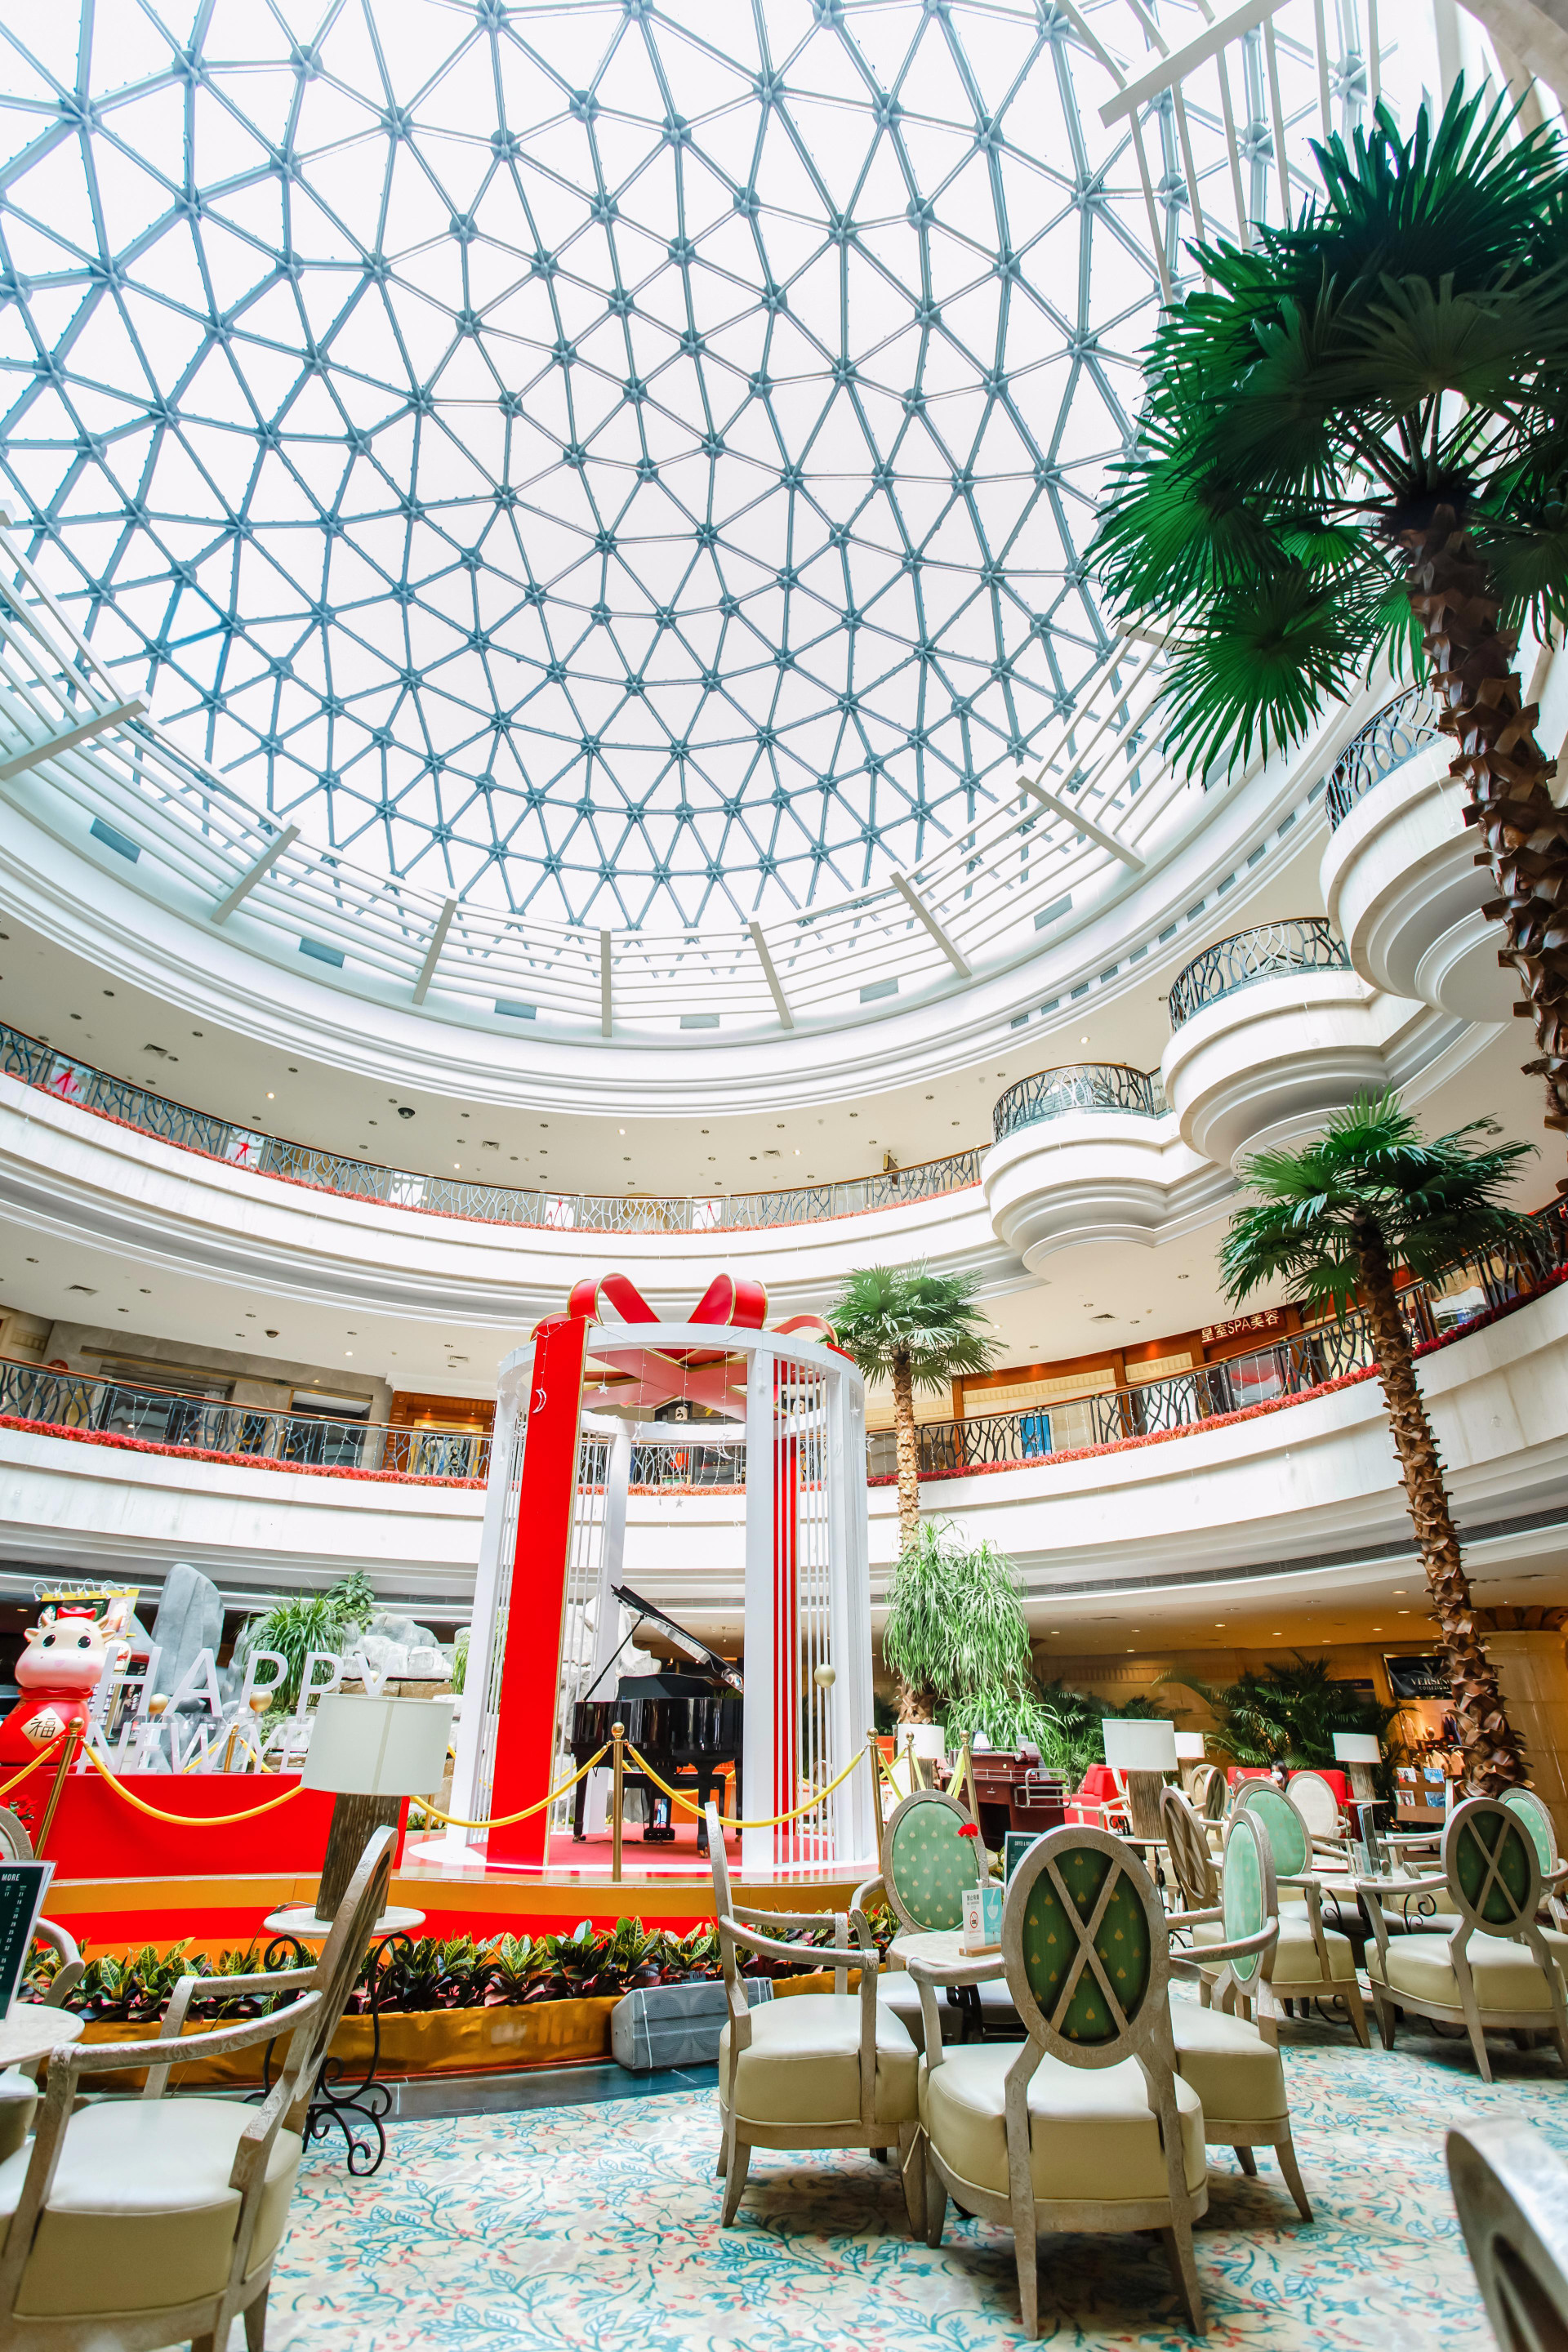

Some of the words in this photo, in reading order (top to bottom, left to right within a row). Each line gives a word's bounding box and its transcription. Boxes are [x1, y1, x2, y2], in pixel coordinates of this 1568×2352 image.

[1201, 1310, 1279, 1343] 皇室SPA美容
[91, 1646, 401, 1718] HAPPY
[29, 1717, 56, 1738] 福
[76, 1722, 235, 1775] NEW
[2, 1873, 20, 1882] MORE
